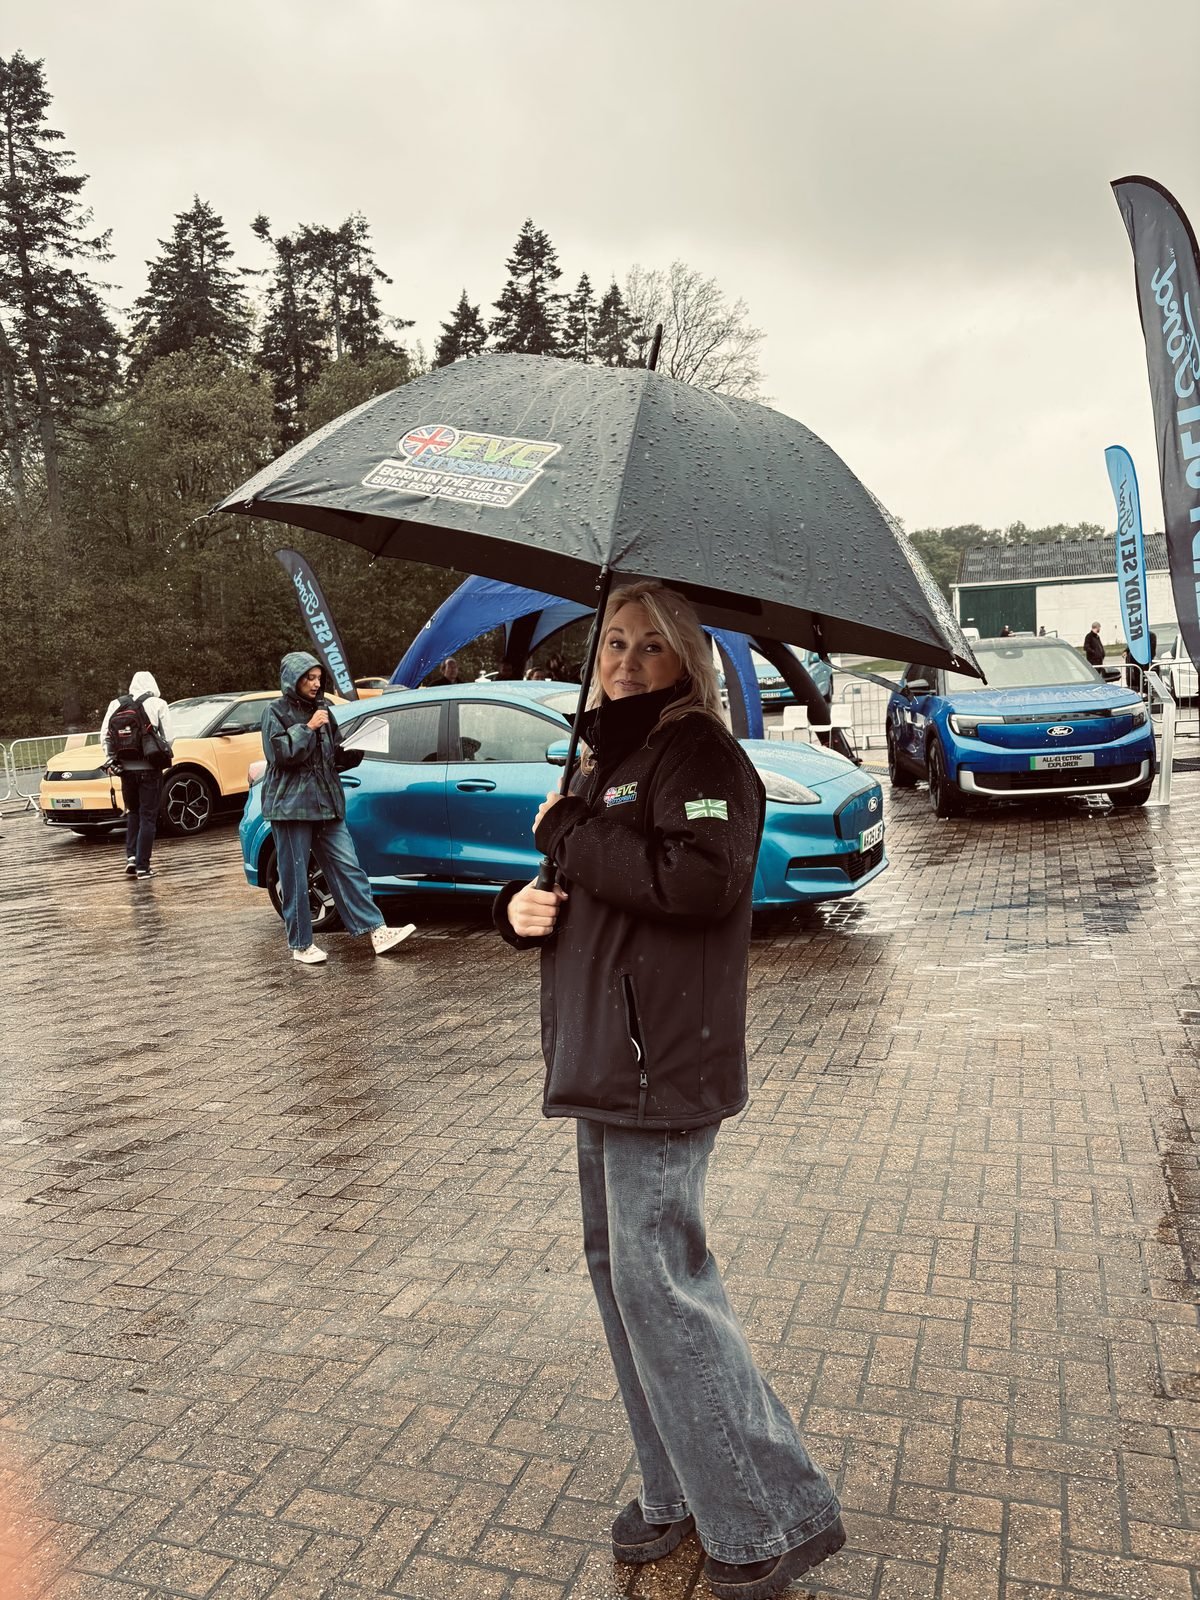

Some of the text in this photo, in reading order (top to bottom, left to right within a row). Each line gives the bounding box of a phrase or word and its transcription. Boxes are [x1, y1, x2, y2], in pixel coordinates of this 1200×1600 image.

[446, 435, 556, 469] EVC
[411, 454, 536, 481] CITYSPRINT
[370, 476, 410, 487] BUILT
[406, 482, 434, 492] FOR
[432, 485, 457, 496] THE
[379, 466, 514, 496] BORN IN THE HILLS.
[1042, 754, 1083, 763] ALL-ELECTRIC
[1047, 761, 1079, 769] EXPLORER
[615, 783, 636, 798] EVC
